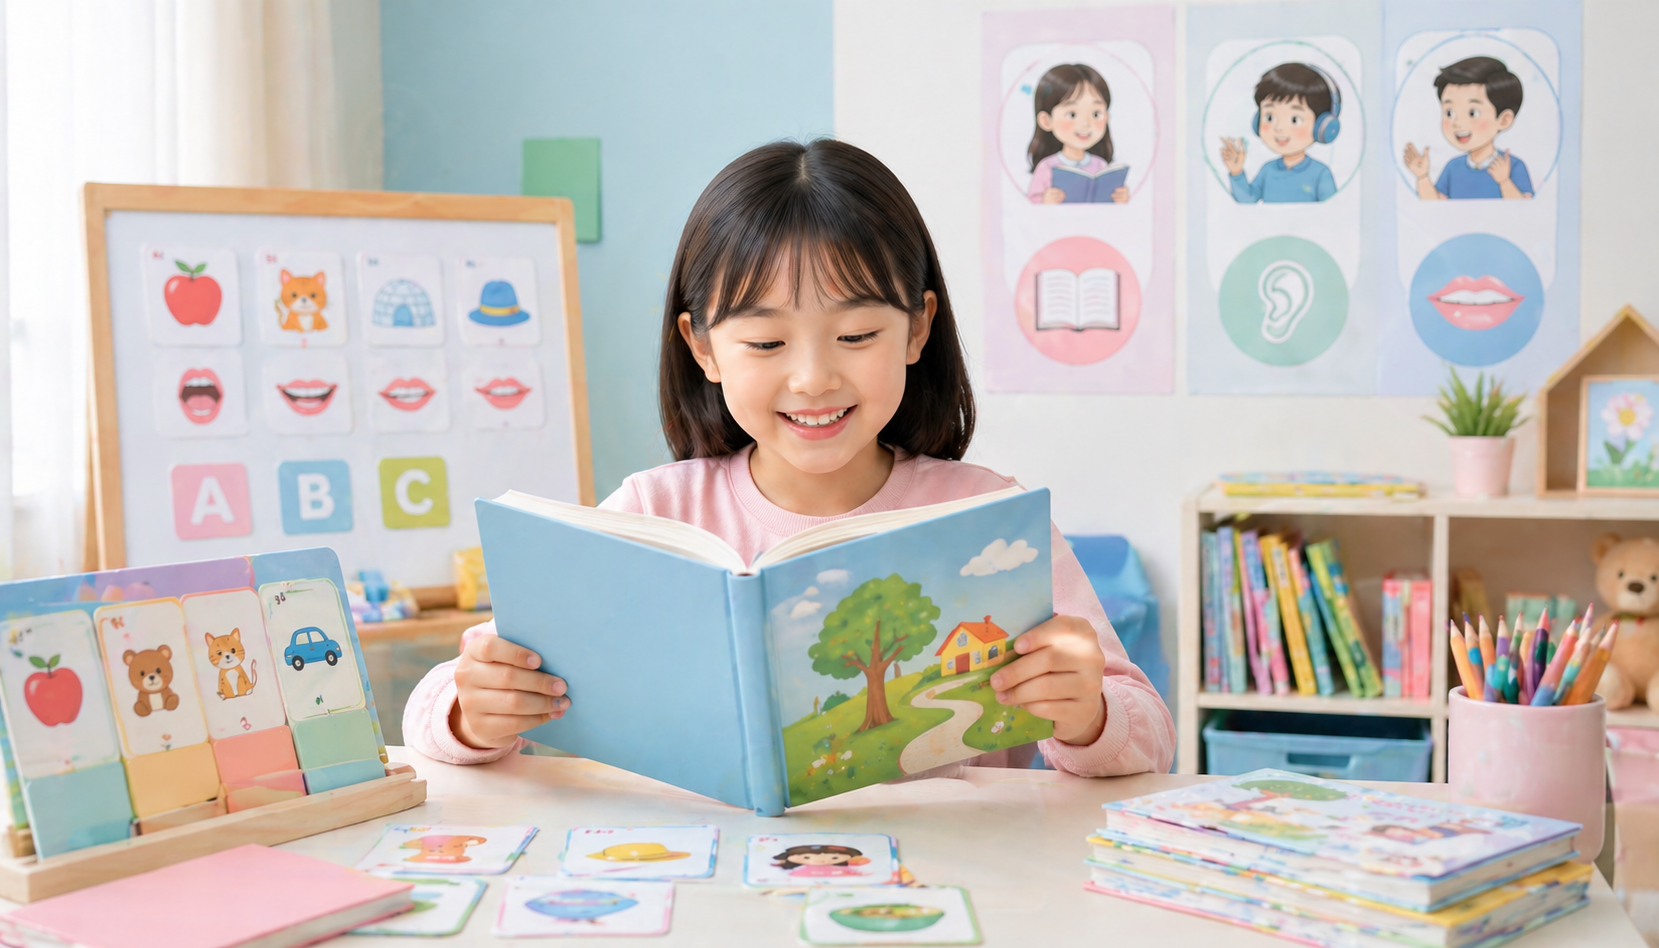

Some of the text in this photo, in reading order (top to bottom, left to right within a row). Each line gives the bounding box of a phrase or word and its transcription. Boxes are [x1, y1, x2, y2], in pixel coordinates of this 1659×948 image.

[192, 468, 433, 525] A B C
